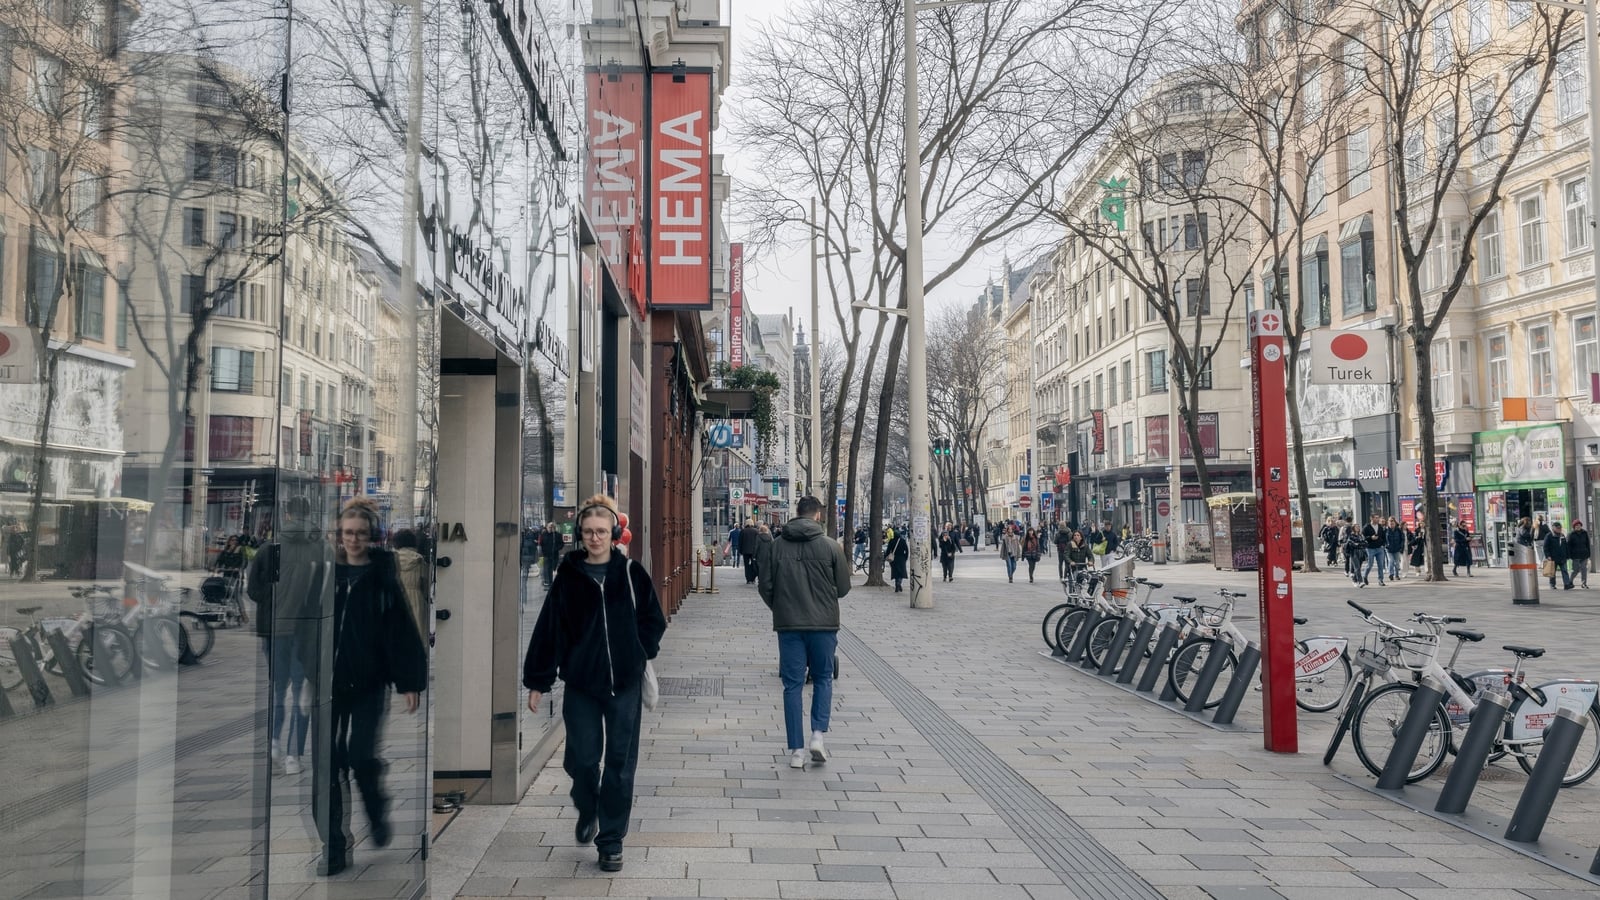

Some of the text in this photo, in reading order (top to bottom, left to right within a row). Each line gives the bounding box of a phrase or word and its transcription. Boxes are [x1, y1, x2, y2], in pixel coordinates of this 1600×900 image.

[660, 111, 702, 265] HEMA
[731, 316, 742, 362] HalfPrice
[1327, 366, 1373, 380] Turek
[714, 430, 727, 445] U
[1359, 466, 1383, 479] swatch
[437, 522, 468, 542] IA
[1303, 656, 1324, 673] Klima
[1323, 649, 1339, 662] rein.
